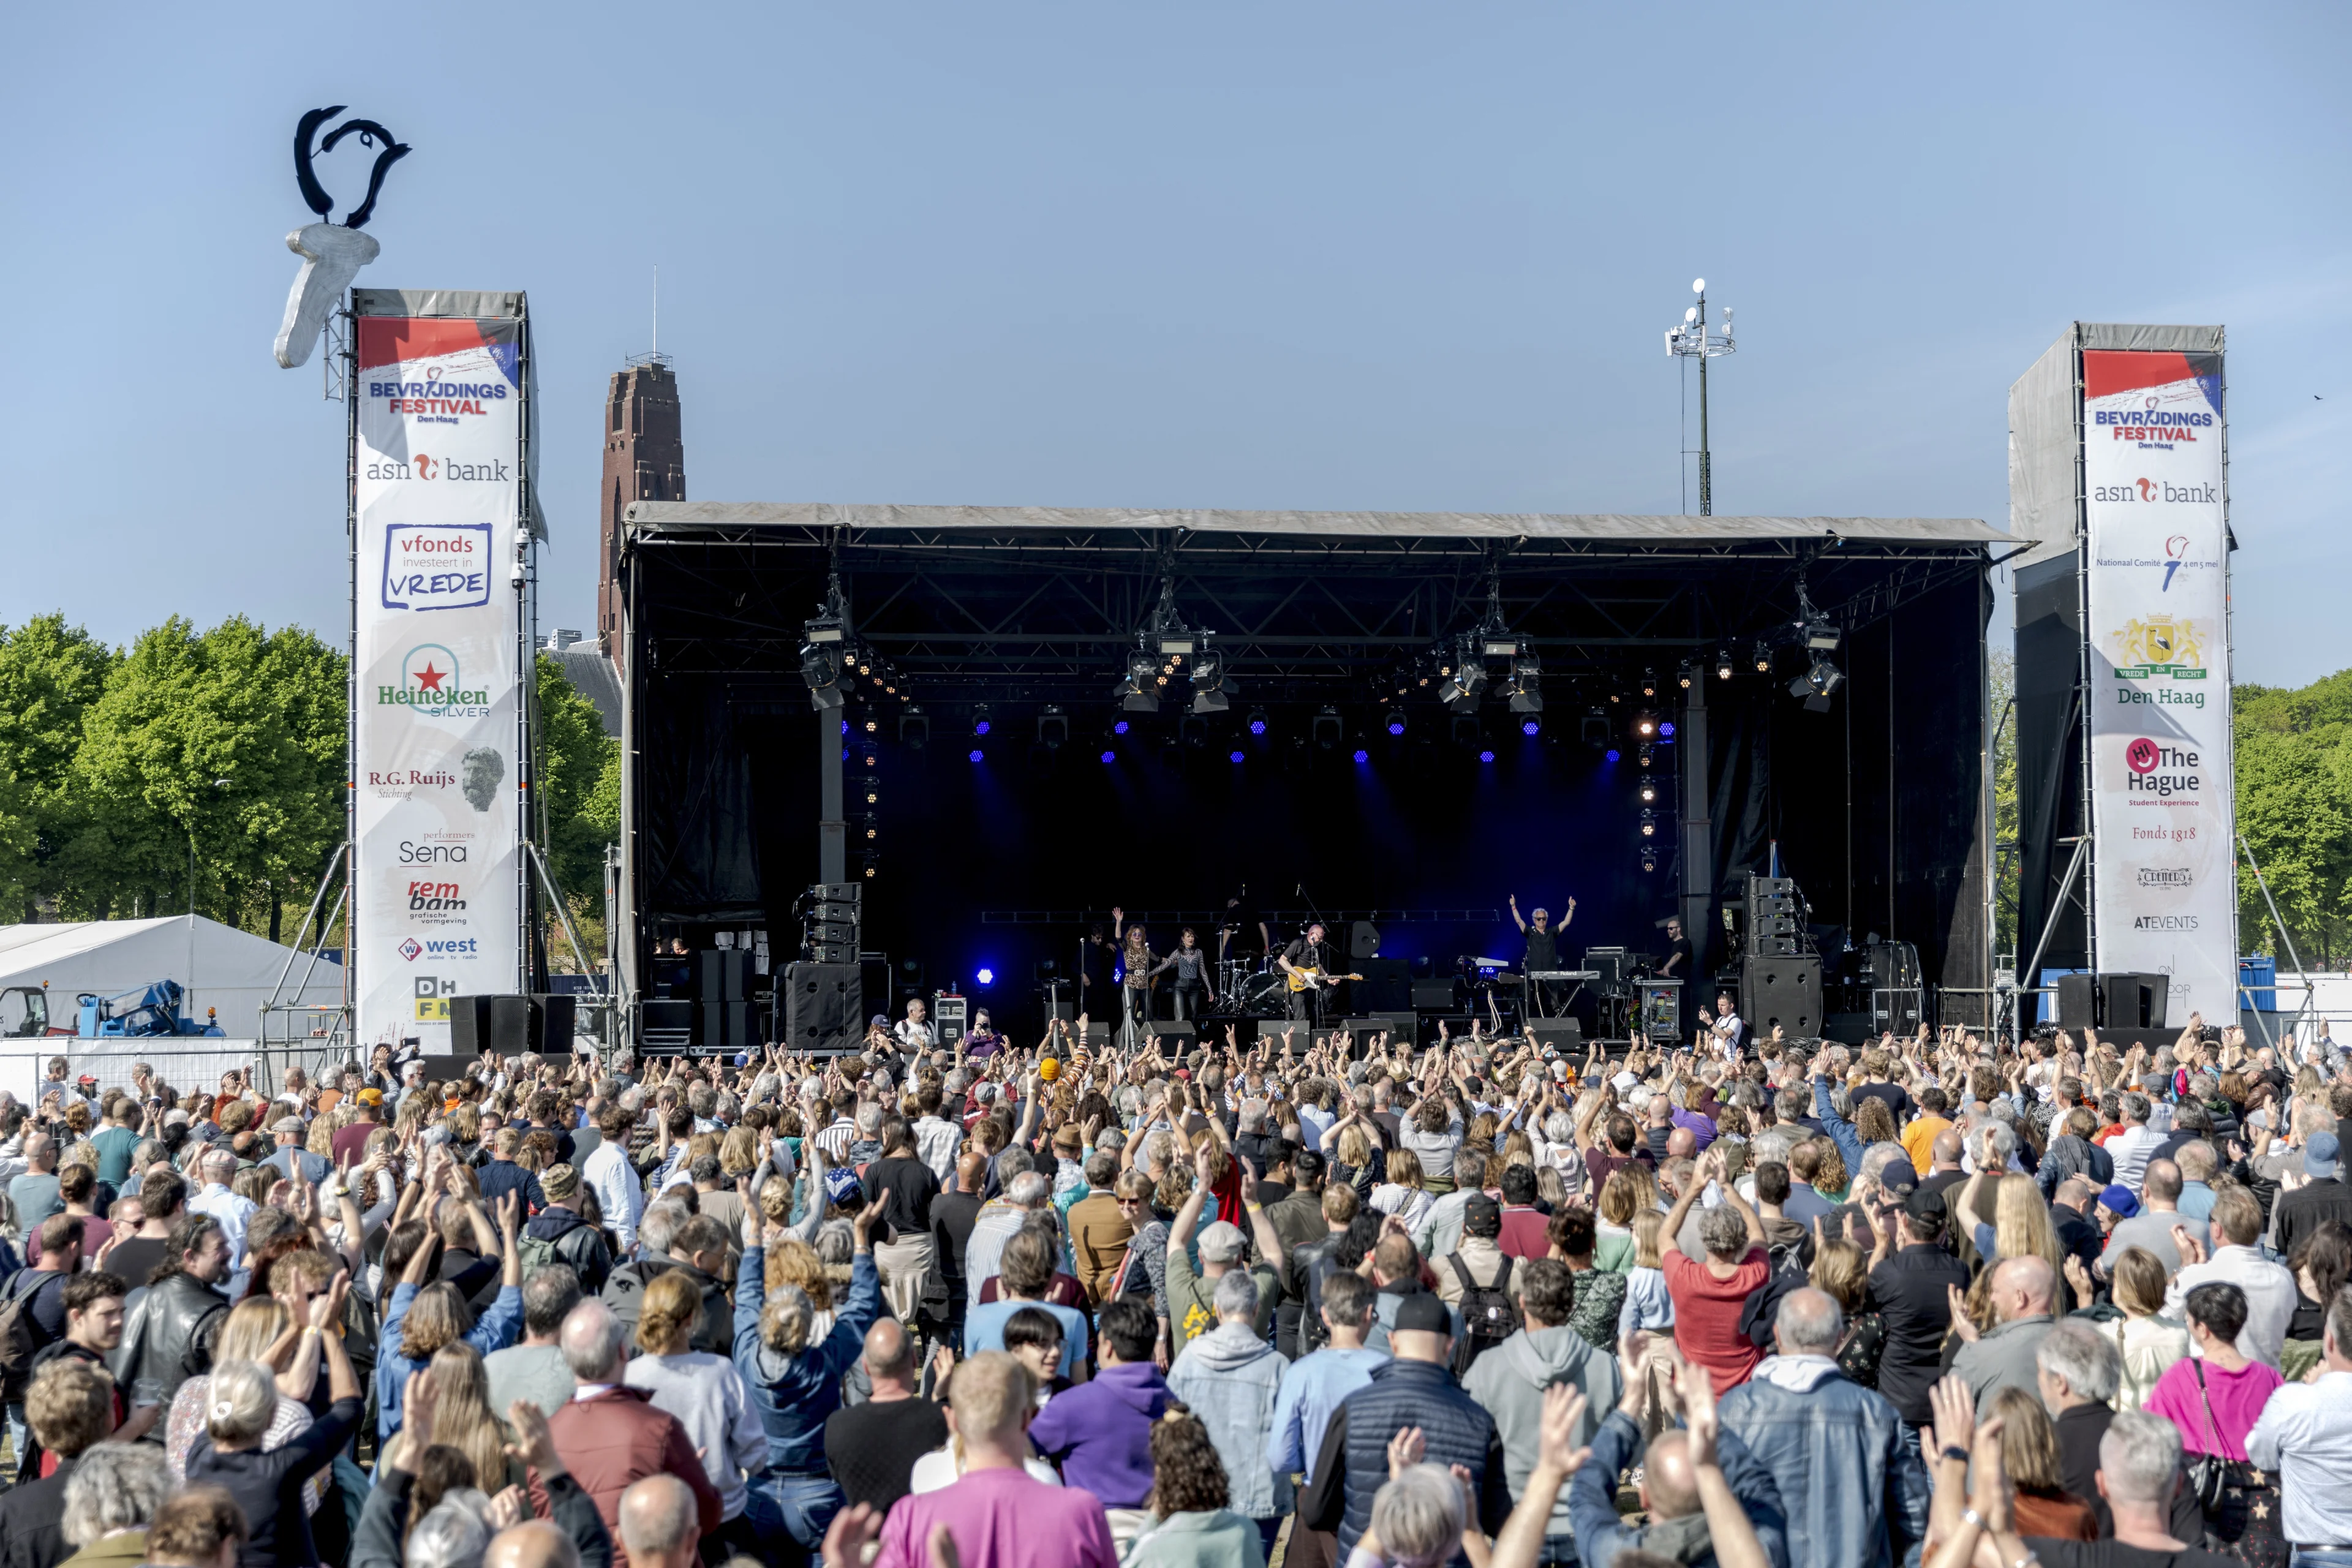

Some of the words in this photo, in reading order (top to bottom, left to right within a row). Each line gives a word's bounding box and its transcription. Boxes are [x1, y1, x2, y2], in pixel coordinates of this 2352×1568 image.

[370, 381, 507, 399] BEVRIJDINGS
[390, 399, 487, 415] FESTIVAL
[435, 416, 459, 424] Haag
[2095, 410, 2212, 427] BEVRIJDINGS
[2113, 426, 2197, 442] FESTIVAL
[367, 462, 412, 480] asn
[445, 458, 509, 481] bank
[2094, 486, 2135, 502] asn
[2163, 481, 2216, 503] bank
[402, 535, 473, 553] vfonds
[403, 557, 458, 567] investeert
[462, 557, 472, 567] in
[389, 573, 484, 596] VREDE
[378, 686, 489, 705] Heineken
[2117, 688, 2153, 704] Den
[2158, 689, 2204, 709] Haag
[431, 707, 490, 717] SILVER
[2132, 743, 2151, 761] HI
[2158, 747, 2199, 767] The
[369, 772, 405, 785] R.G.
[409, 770, 455, 790] Ruijs
[2128, 772, 2199, 796] Hague
[377, 788, 412, 801] Stichting
[423, 829, 475, 842] performers
[2132, 825, 2167, 840] Fonds
[2171, 827, 2196, 842] 1818
[399, 841, 467, 862] Sena
[2144, 872, 2186, 882] CREMERS
[407, 881, 459, 899] rem
[409, 890, 467, 910] bam
[405, 945, 416, 954] W
[426, 938, 477, 952] west
